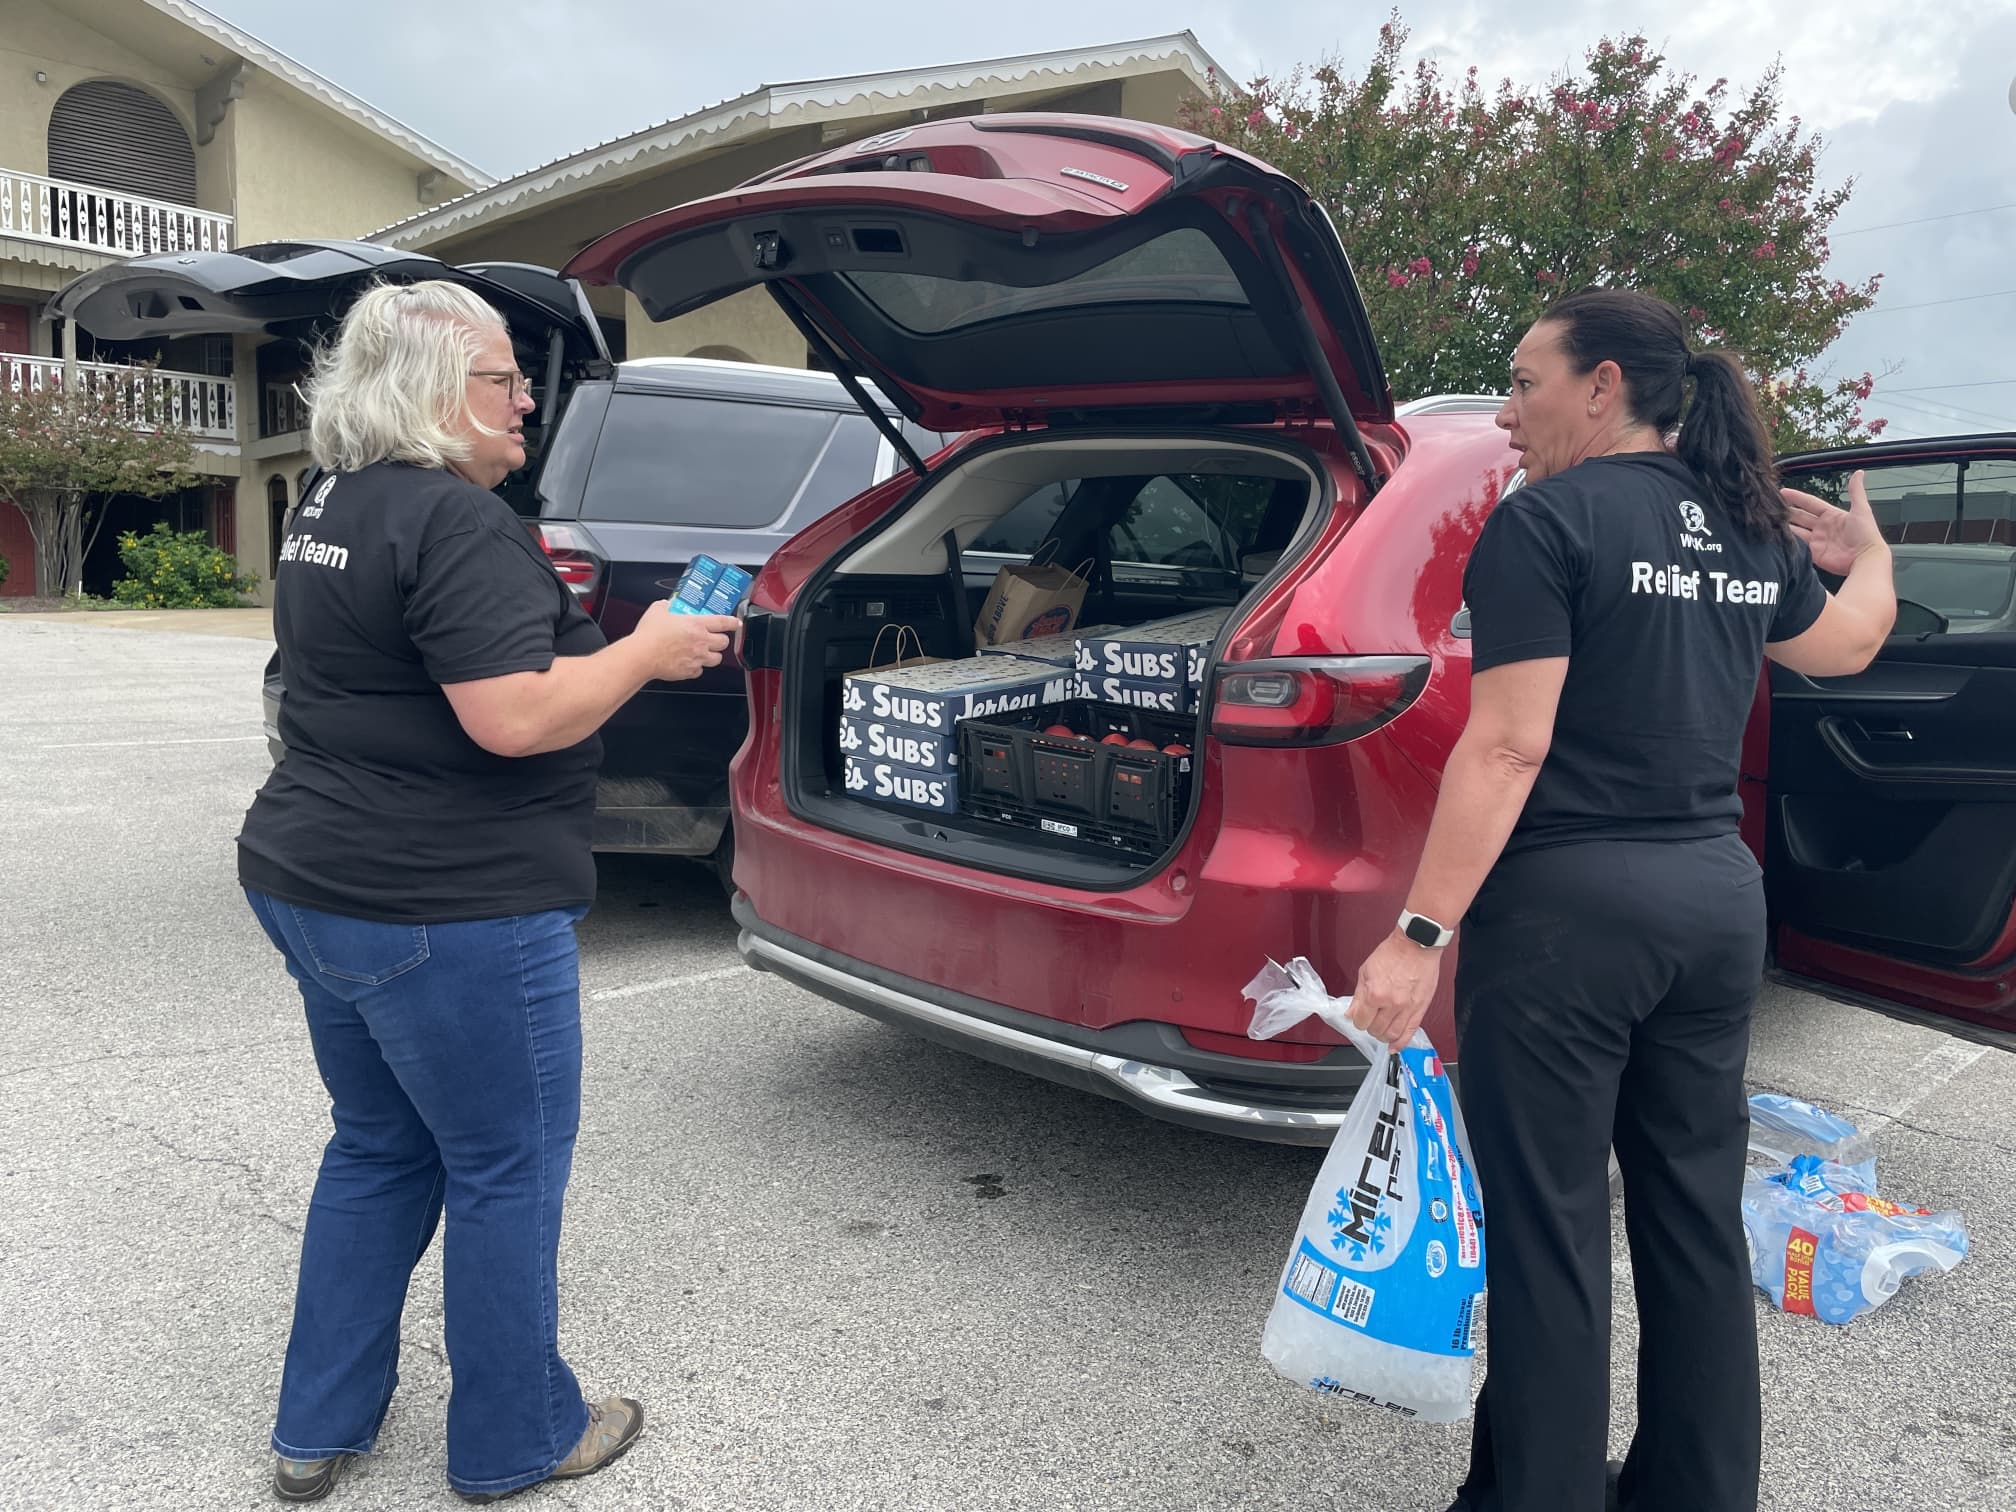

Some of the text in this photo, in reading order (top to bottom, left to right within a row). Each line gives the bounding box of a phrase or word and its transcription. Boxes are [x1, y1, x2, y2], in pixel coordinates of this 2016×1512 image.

[299, 534, 349, 570] Team
[1631, 561, 1779, 605] Relief Team
[1788, 1238, 1815, 1257] 40
[1786, 1266, 1798, 1300] PACK
[1798, 1269, 1810, 1301] VALUE
